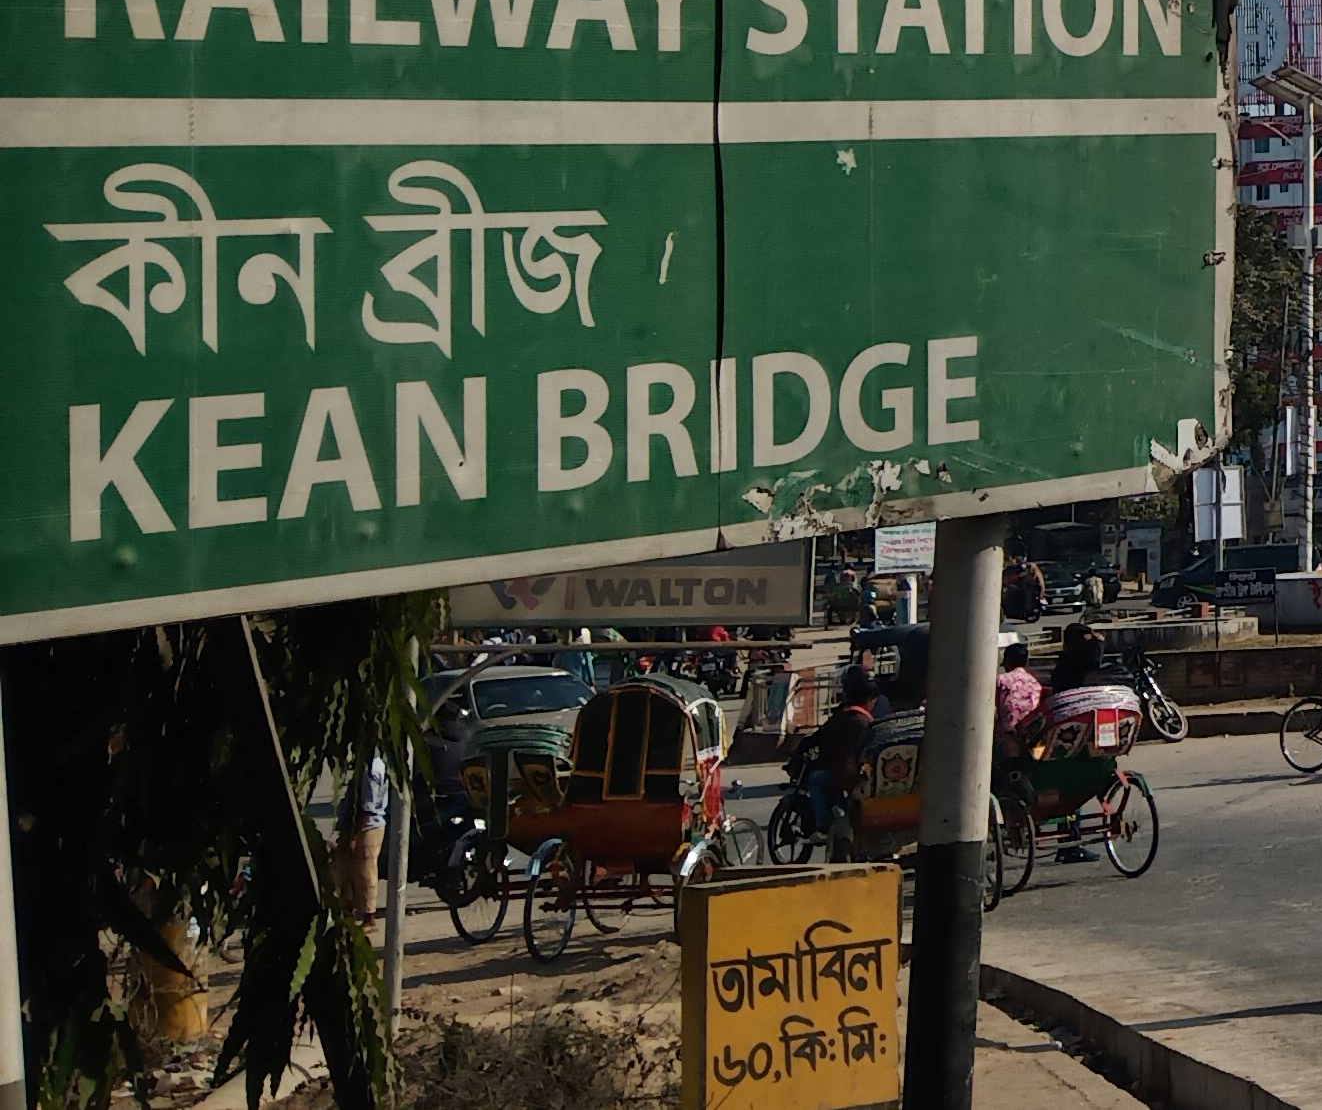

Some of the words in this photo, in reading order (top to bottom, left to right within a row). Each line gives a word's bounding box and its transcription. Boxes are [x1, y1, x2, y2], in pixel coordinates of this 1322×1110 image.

[44, 163, 333, 356] কীন
[362, 161, 608, 358] ব্রীজ
[68, 377, 489, 542] KEAN
[537, 336, 981, 491] BRIDGE
[586, 578, 768, 607] WALTON
[710, 920, 892, 1012] তামাবিল
